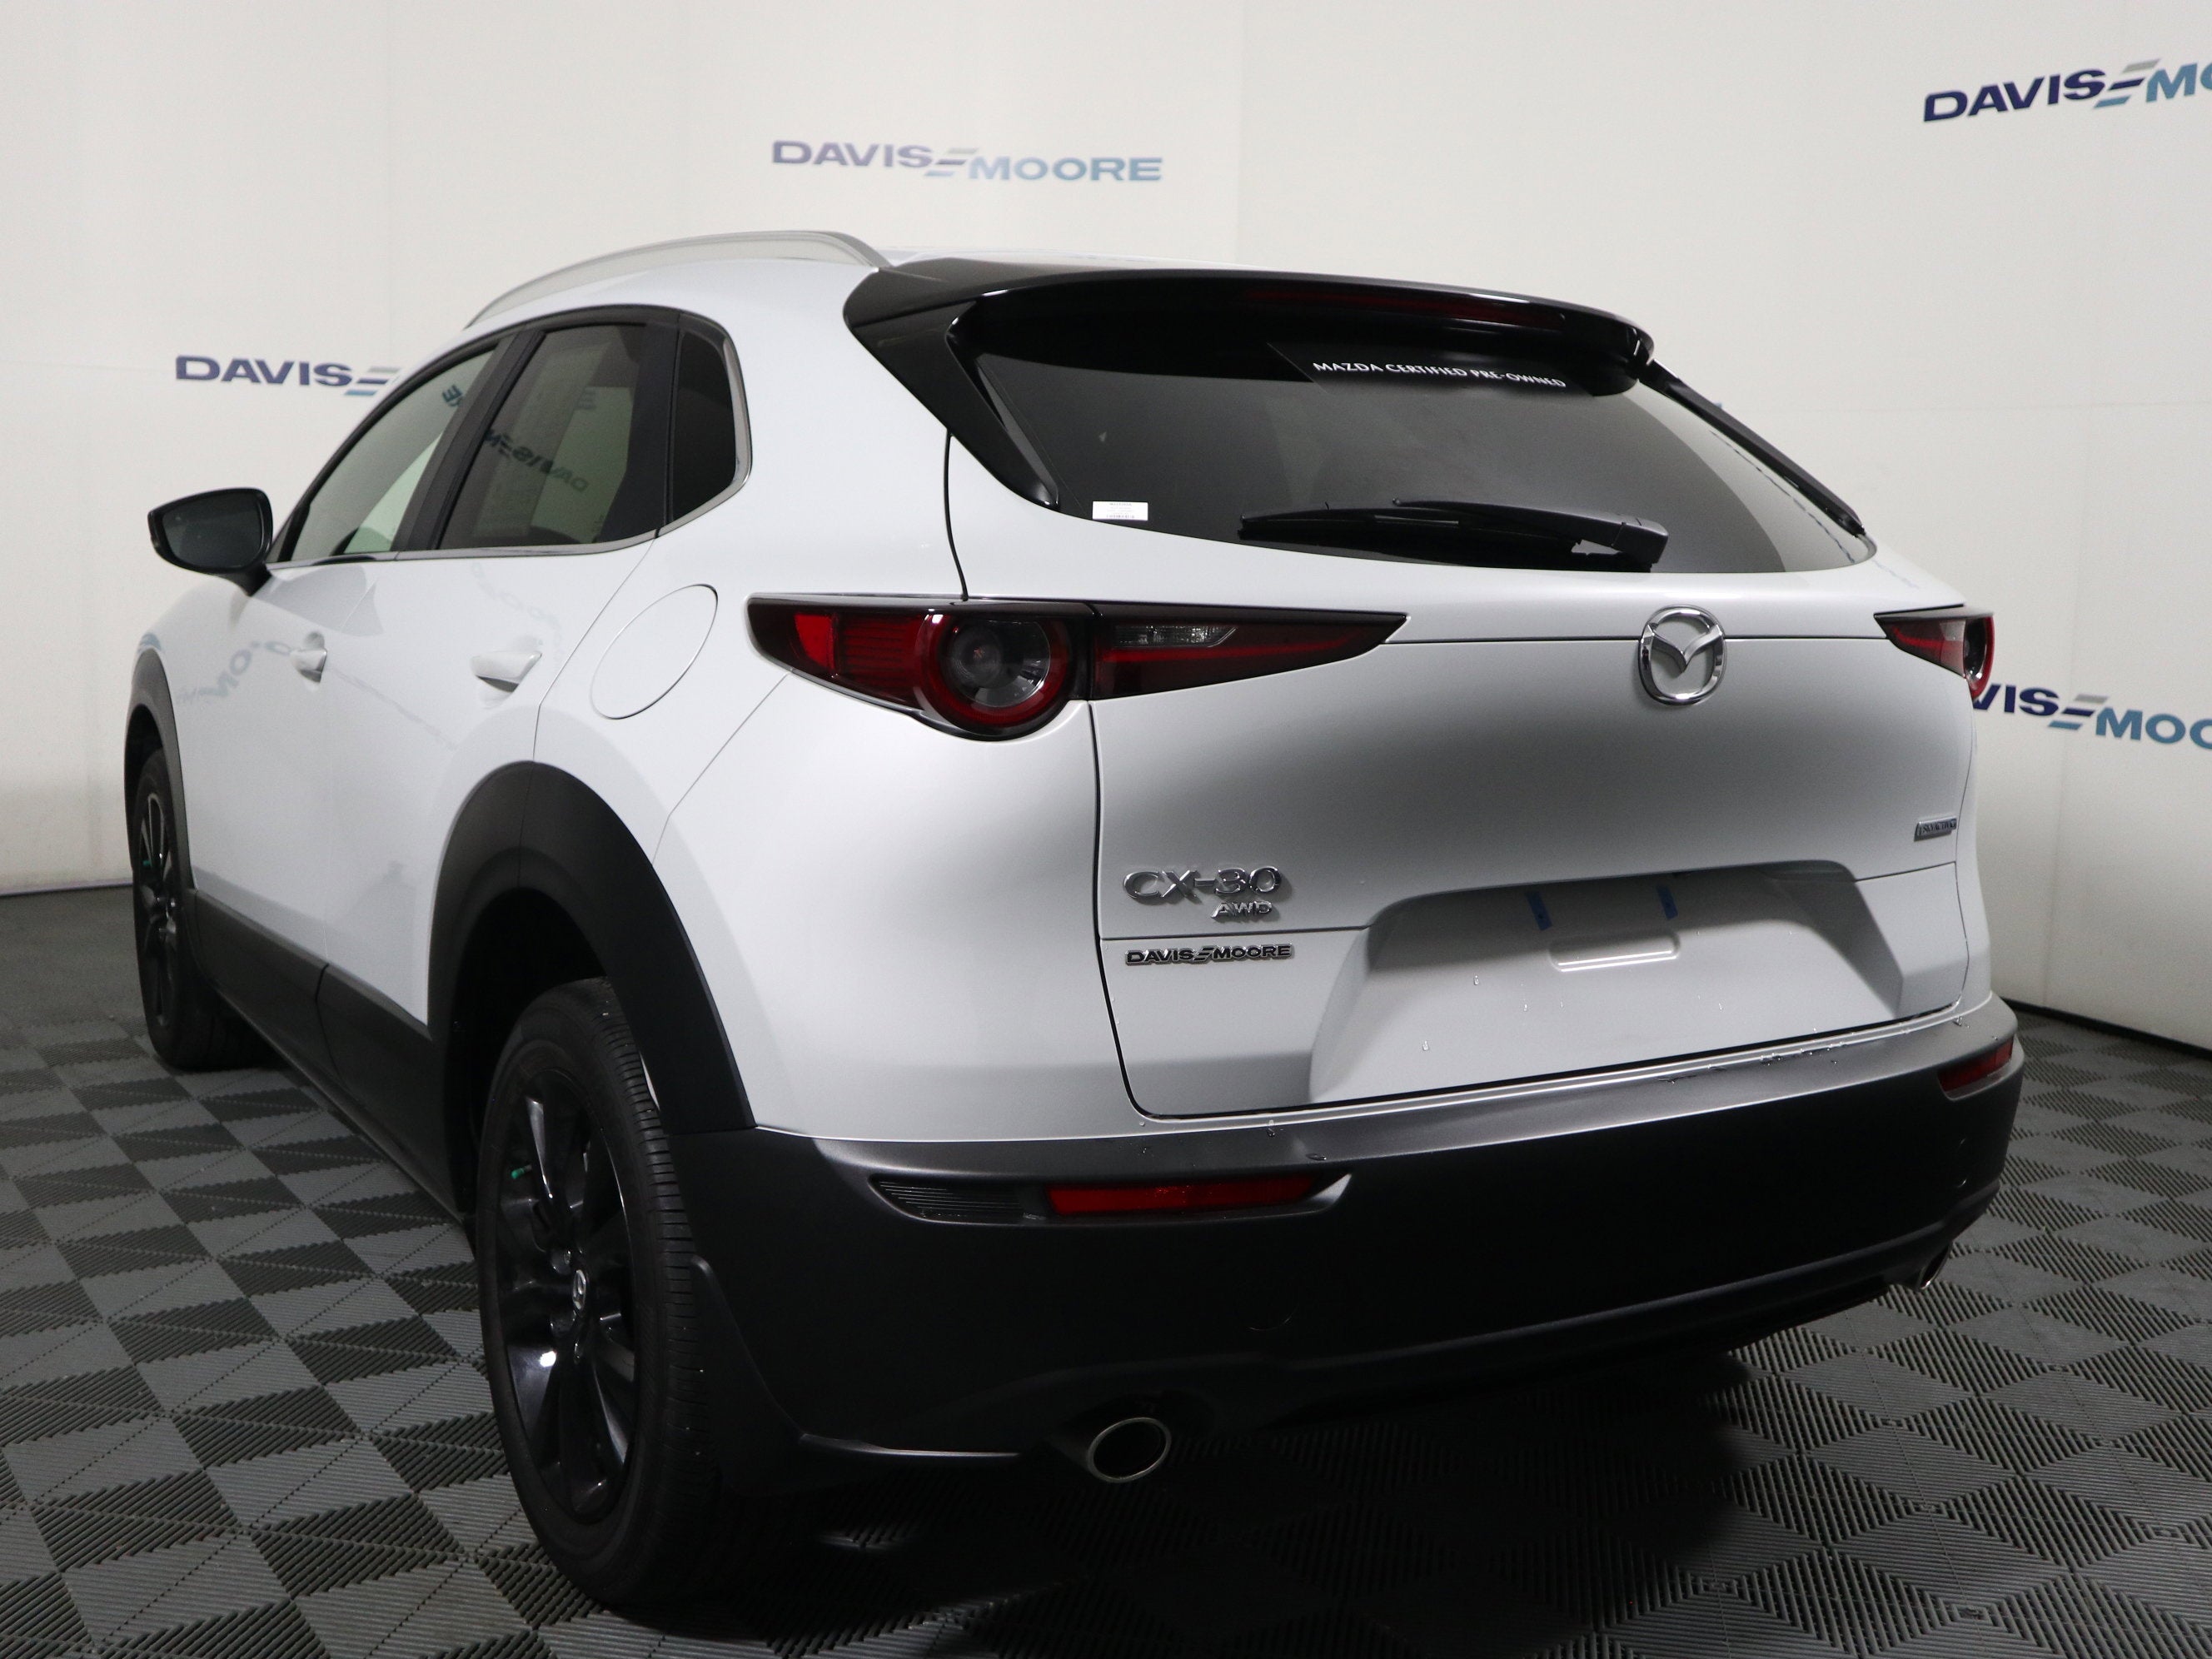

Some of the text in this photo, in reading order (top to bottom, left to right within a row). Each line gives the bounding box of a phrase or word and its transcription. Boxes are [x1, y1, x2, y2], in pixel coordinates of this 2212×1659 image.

[1923, 62, 2212, 122] DAVIS M
[772, 140, 1163, 182] DAVIS MOORE
[175, 355, 353, 386] DAVIS
[1313, 362, 1567, 388] MAZDA CERTIFIED PRE-OWNED
[1123, 865, 1283, 899] CX-30
[1210, 899, 1273, 919] AWD
[1125, 943, 1293, 964] DAVIS MOORE
